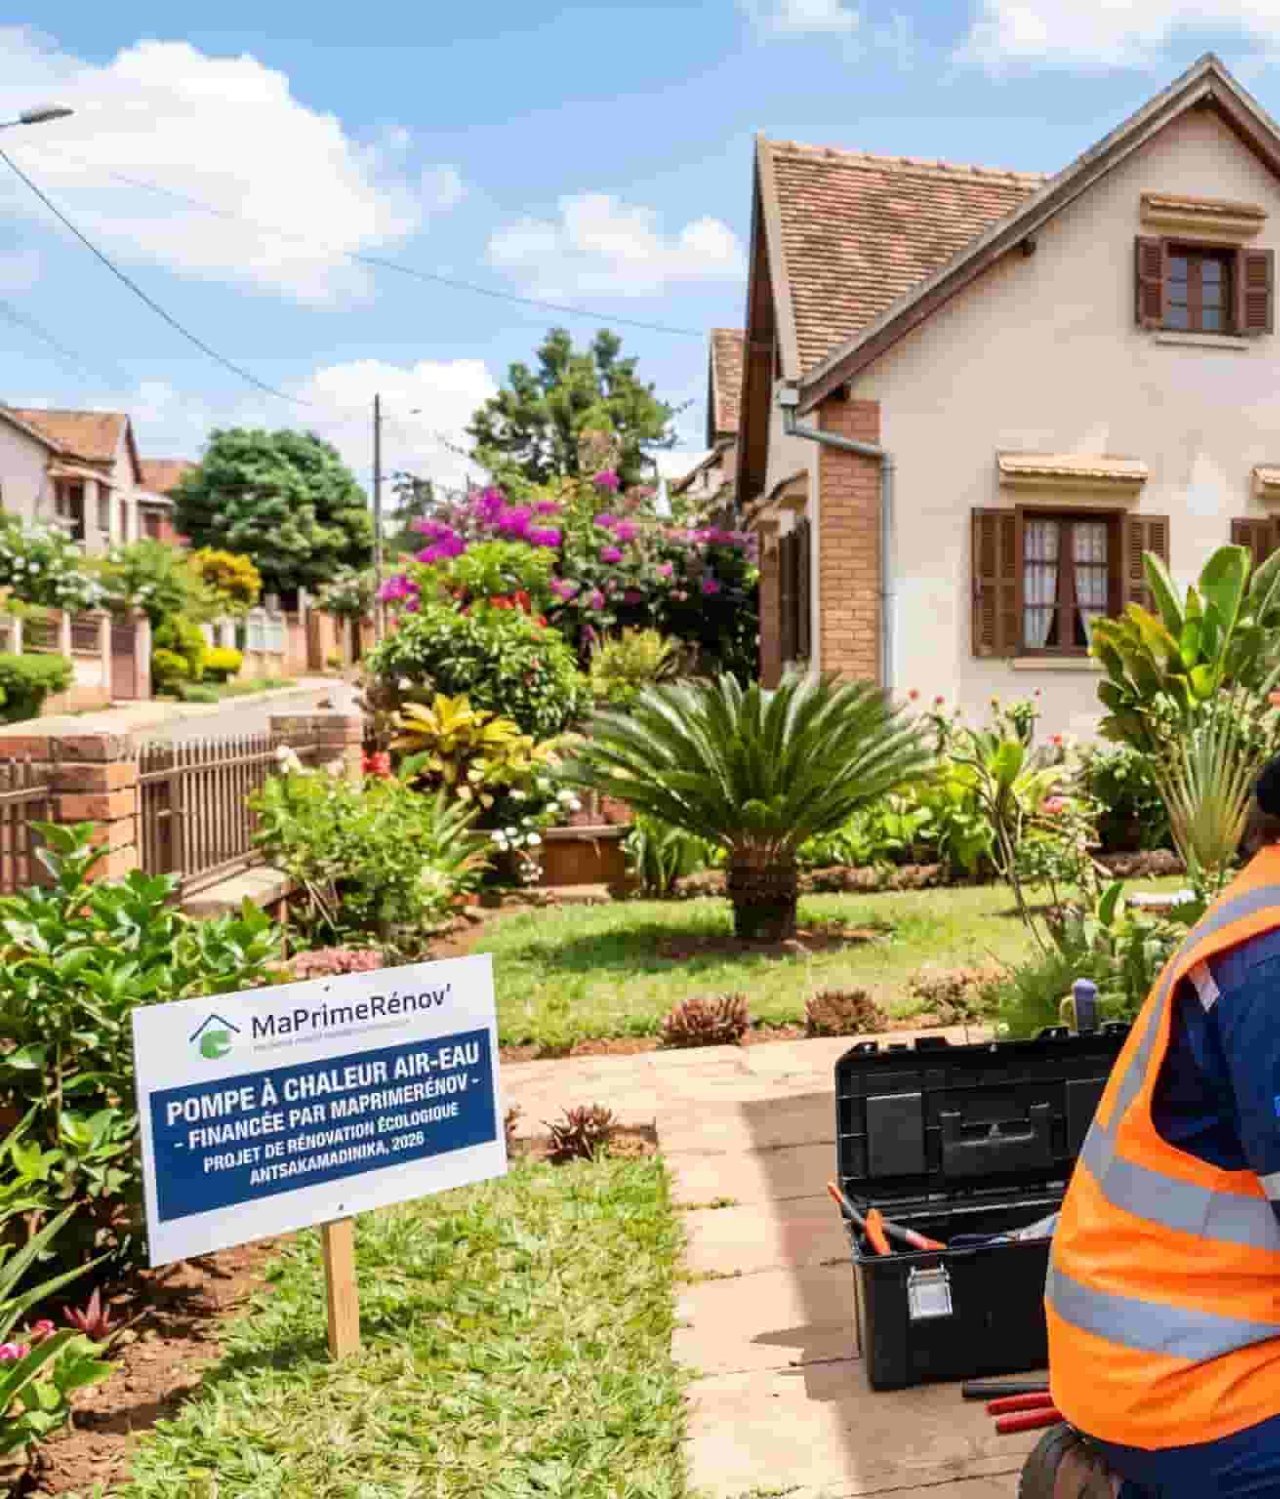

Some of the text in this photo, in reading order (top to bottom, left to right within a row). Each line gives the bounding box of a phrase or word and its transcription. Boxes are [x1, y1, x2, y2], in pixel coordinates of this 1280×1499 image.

[166, 1040, 480, 1126] POMPE À CHALEUR AIR-EAU
[188, 1112, 285, 1150] FINANCÉE
[289, 1104, 327, 1129] PAR
[330, 1073, 468, 1120] MAPRIMERÉNOV
[203, 1101, 460, 1174] PROJET DE RÉNOVATION ÉCOLOGIQUE
